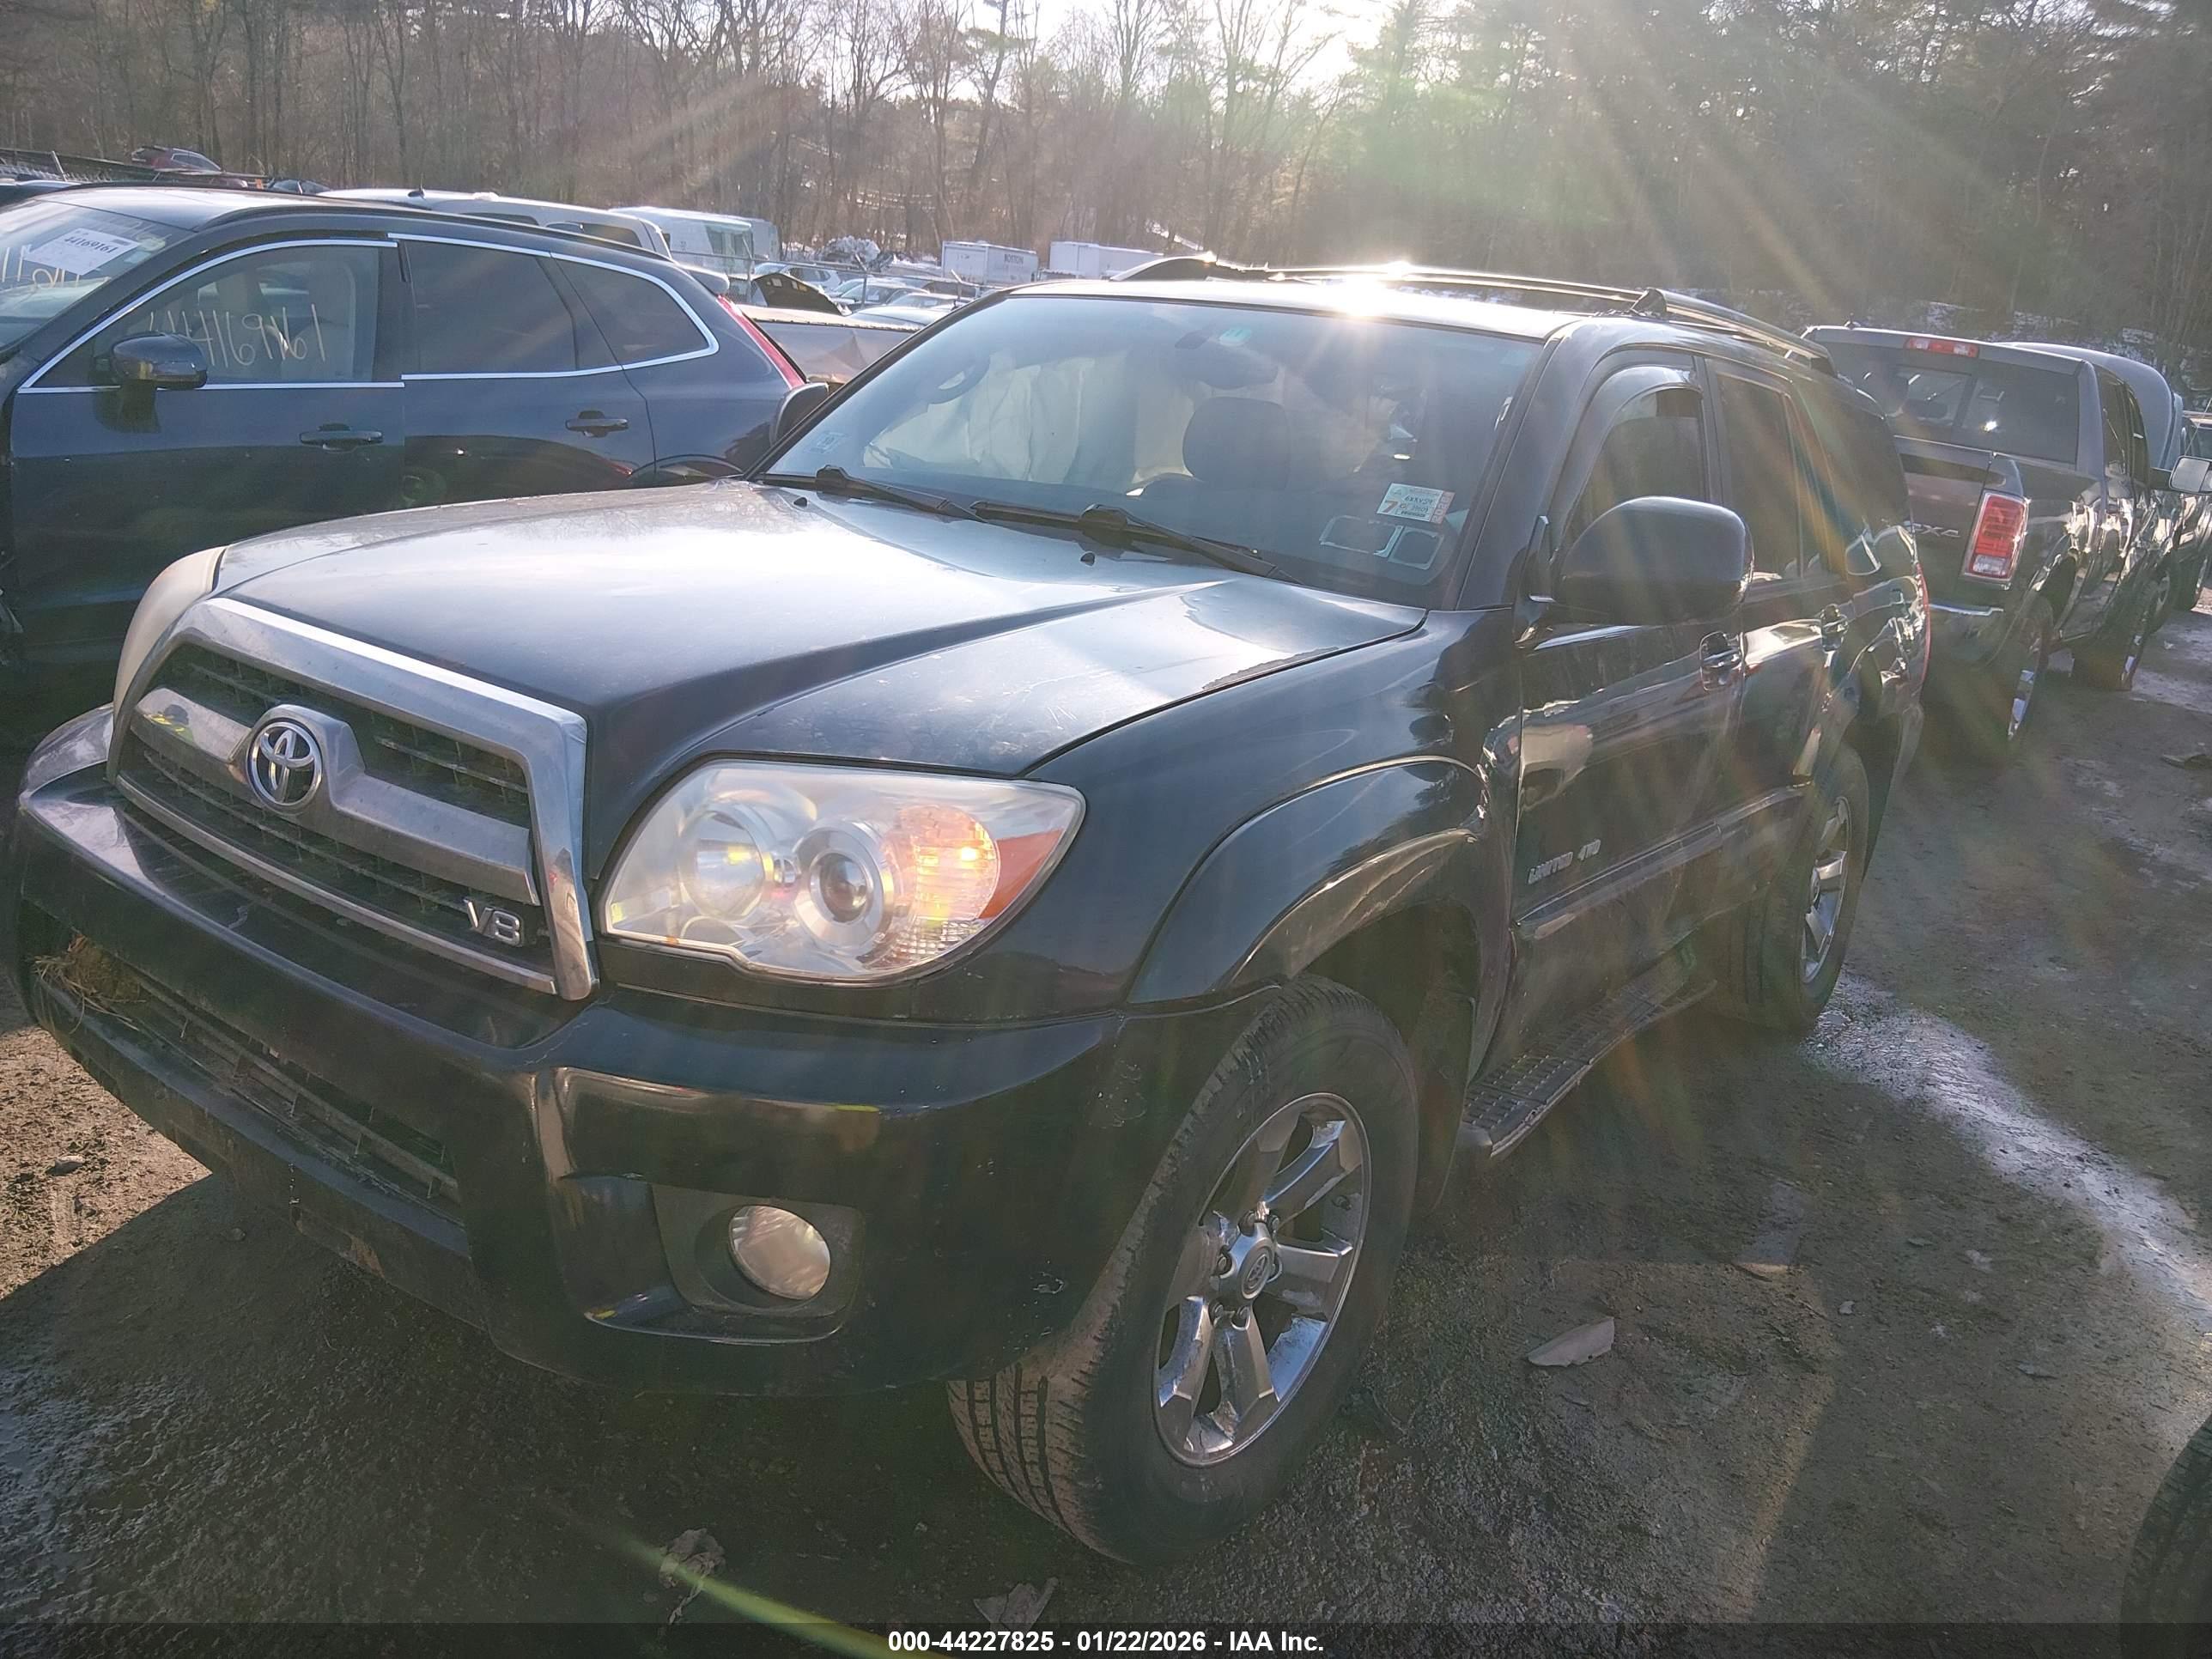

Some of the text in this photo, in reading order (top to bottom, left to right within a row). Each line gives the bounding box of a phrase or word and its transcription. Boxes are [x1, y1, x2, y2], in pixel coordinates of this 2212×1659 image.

[64, 235, 120, 255] 44169161
[1382, 500, 1399, 513] 7
[462, 896, 524, 948] V8
